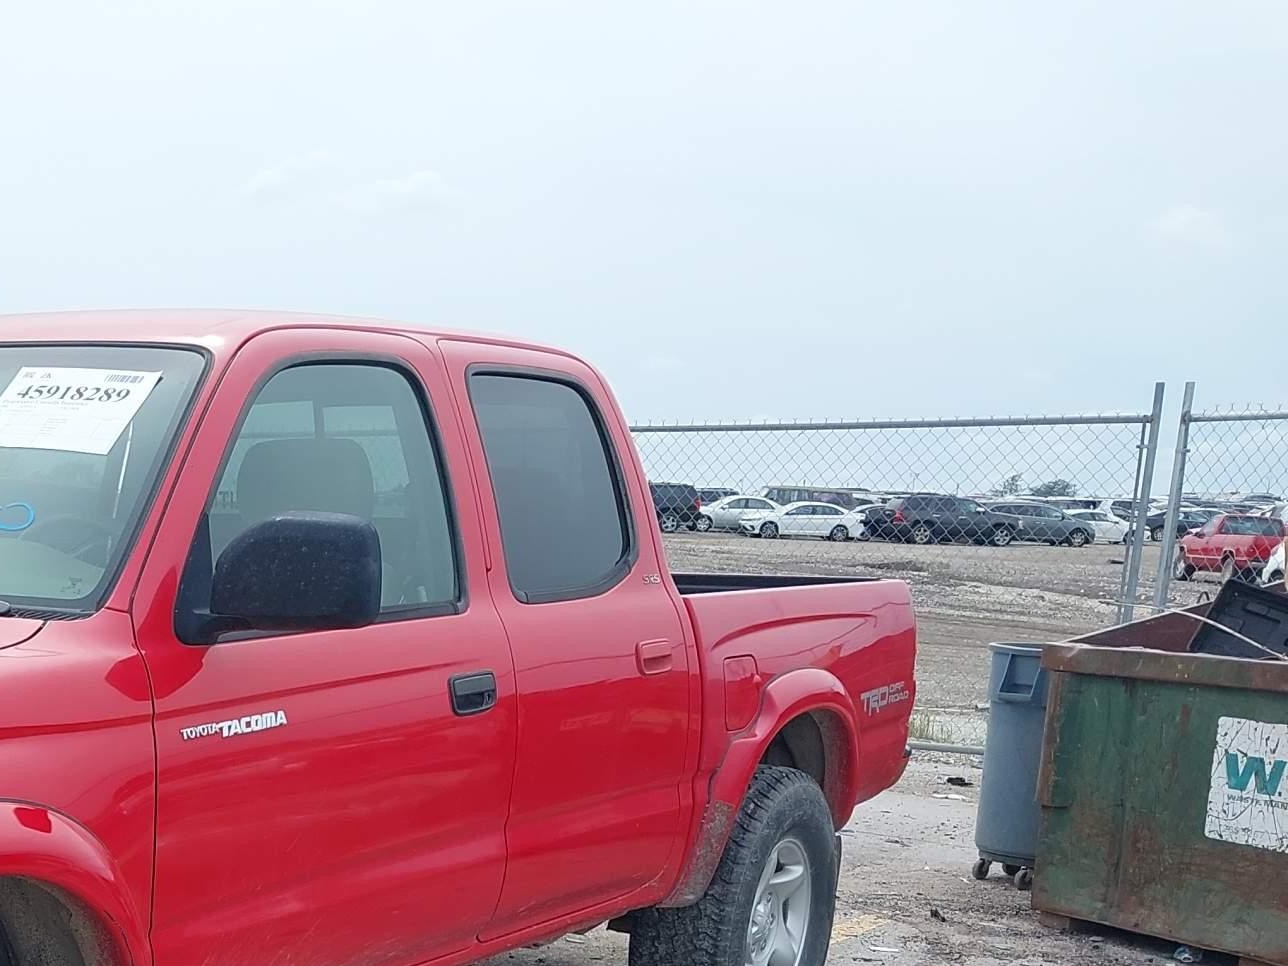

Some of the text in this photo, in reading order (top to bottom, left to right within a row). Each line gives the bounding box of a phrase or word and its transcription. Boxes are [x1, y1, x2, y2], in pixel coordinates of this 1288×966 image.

[16, 384, 132, 403] 45918289
[861, 687, 889, 717] TRD
[889, 691, 909, 704] ROAD
[180, 710, 288, 740] TOYOTA TACOMA
